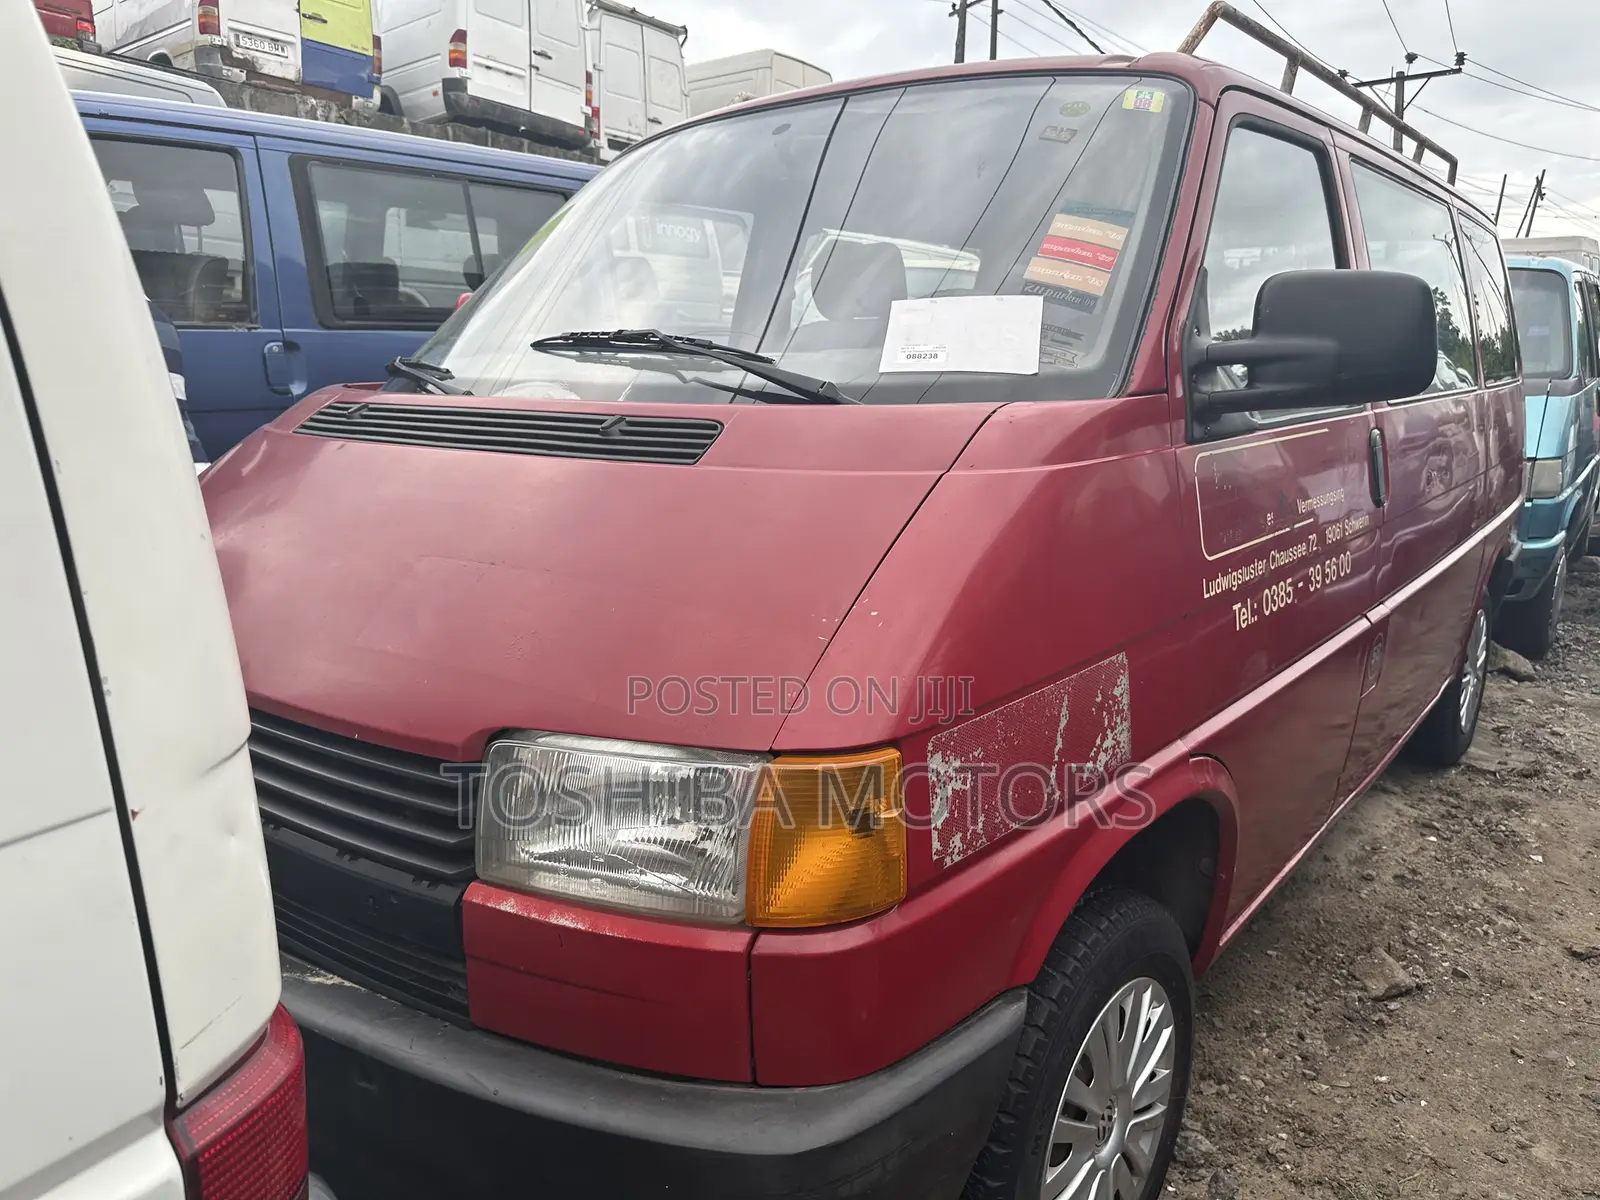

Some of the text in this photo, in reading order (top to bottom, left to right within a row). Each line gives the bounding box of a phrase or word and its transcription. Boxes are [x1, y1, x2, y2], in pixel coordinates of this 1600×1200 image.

[1203, 557, 1267, 599] Ludwigsluster
[1269, 541, 1307, 570] Chaussee
[1325, 527, 1344, 545] 19061
[1232, 598, 1258, 631] Tel.:
[1262, 577, 1294, 616] 0385
[1308, 563, 1322, 592] 39
[1324, 556, 1337, 584] 56
